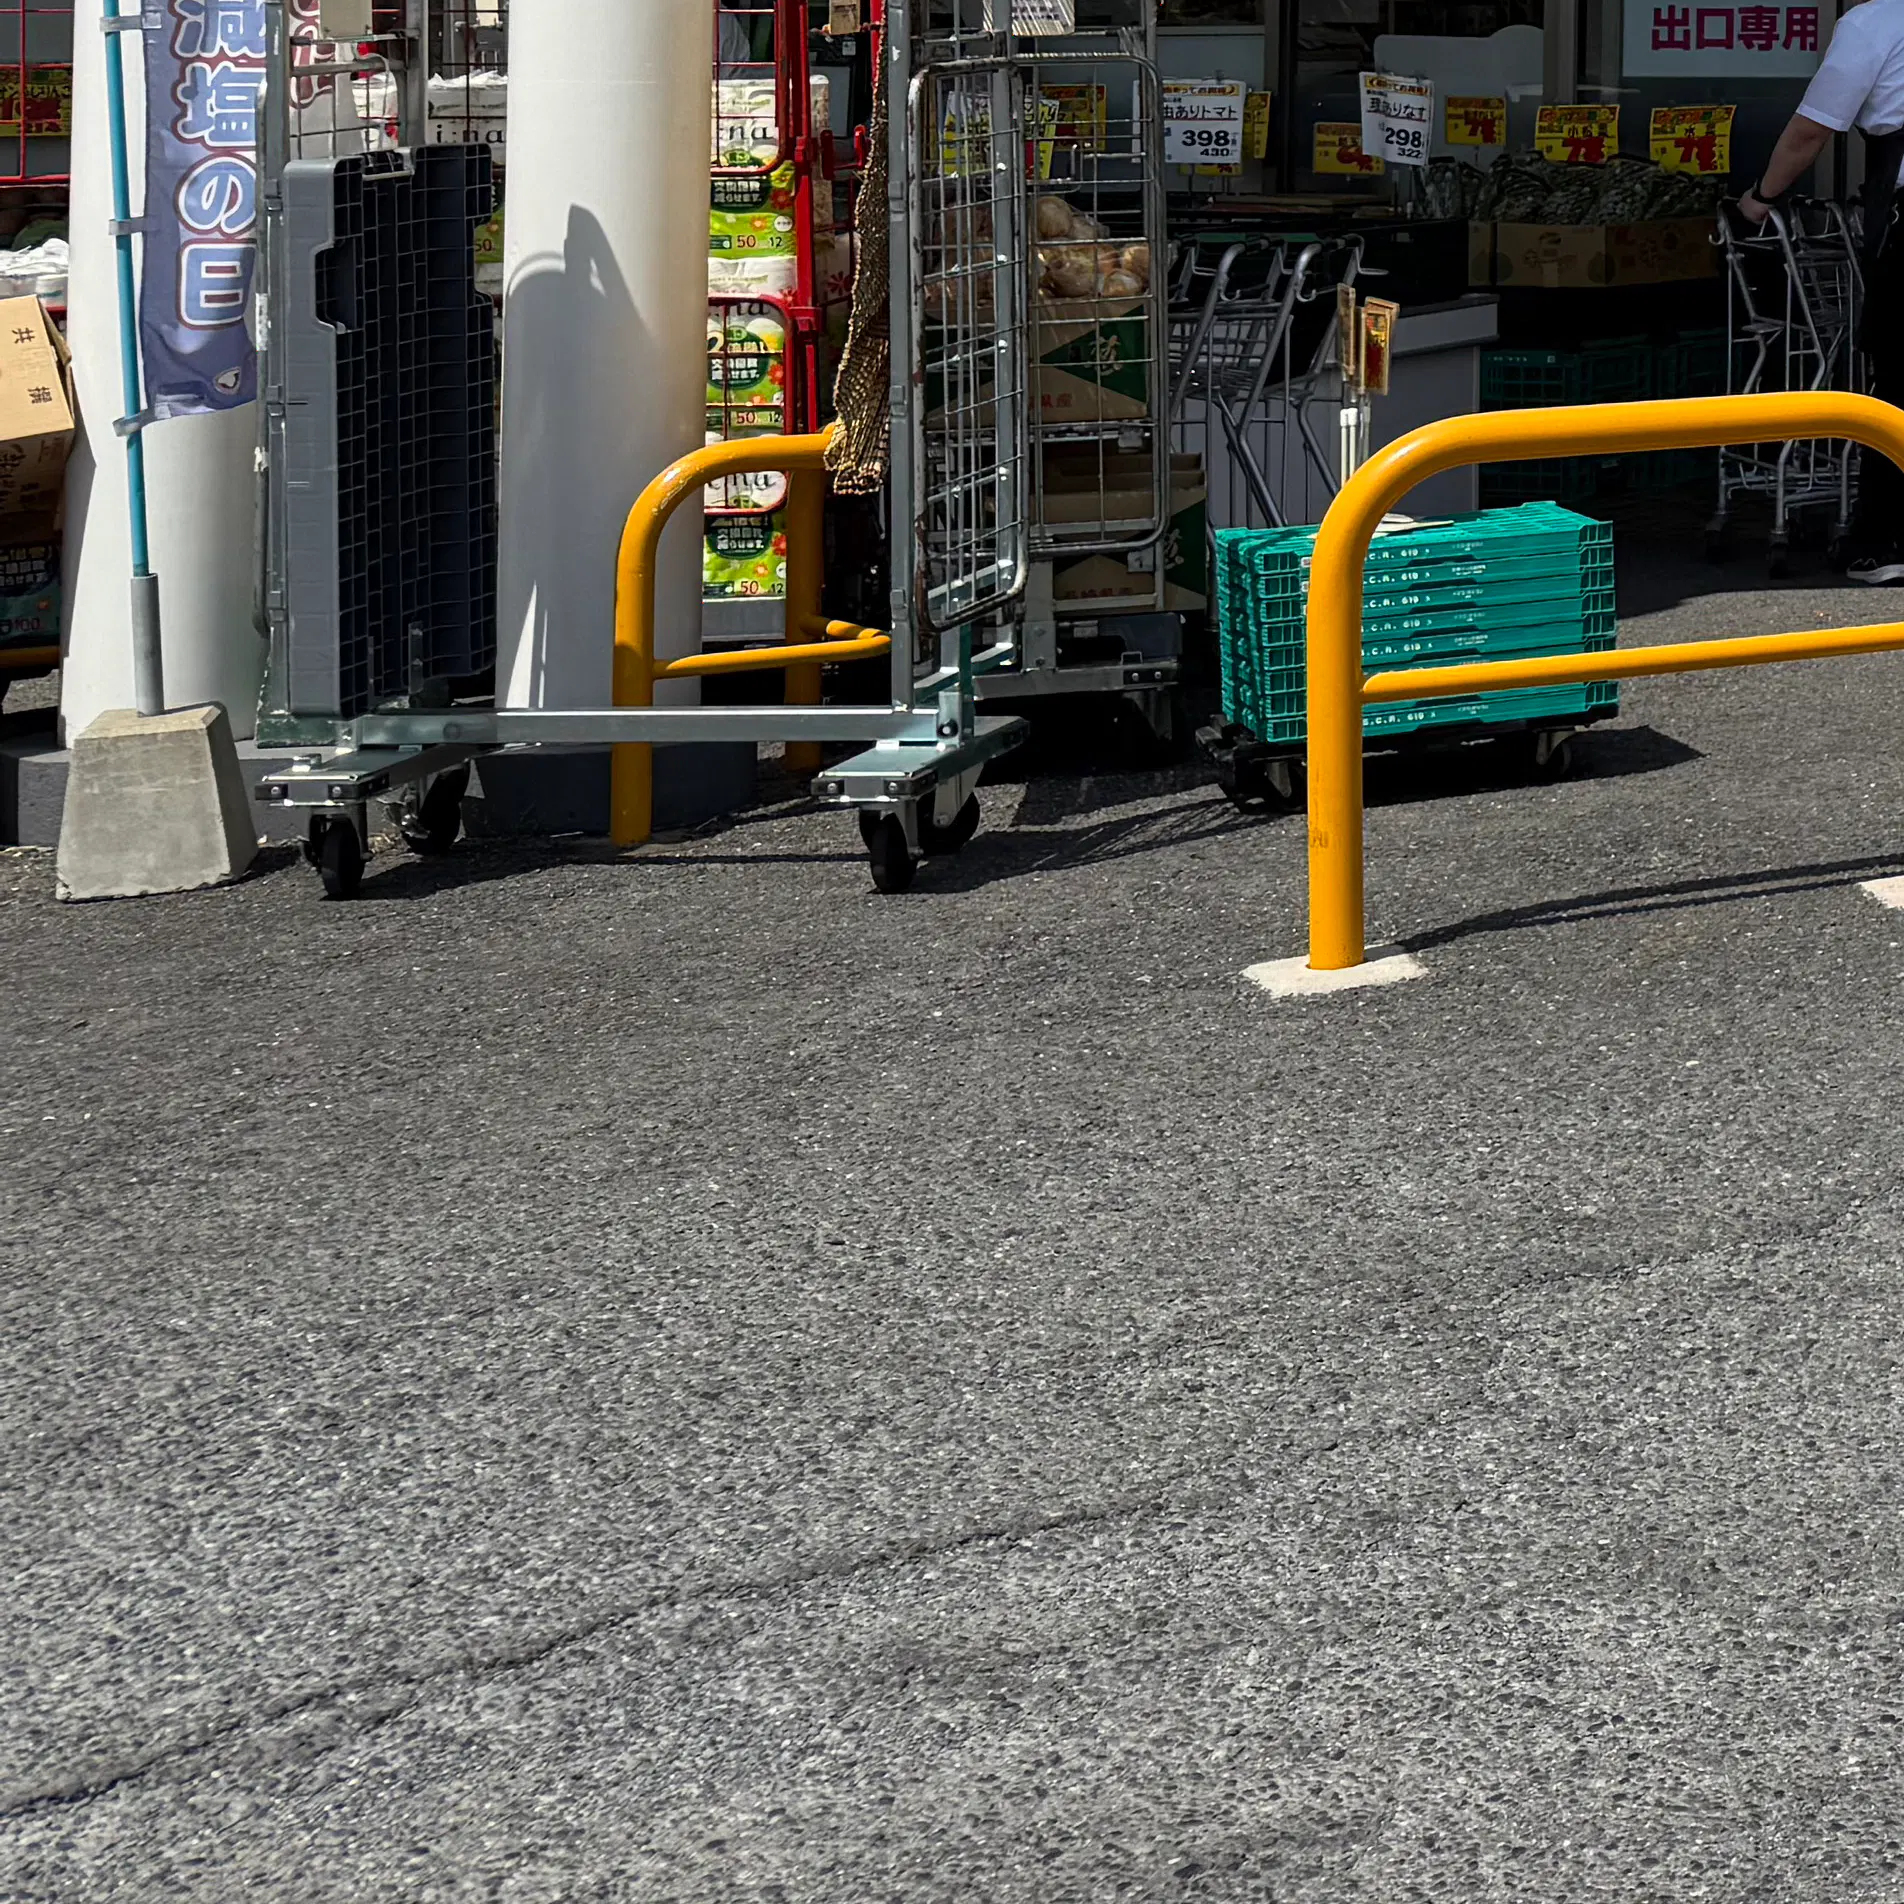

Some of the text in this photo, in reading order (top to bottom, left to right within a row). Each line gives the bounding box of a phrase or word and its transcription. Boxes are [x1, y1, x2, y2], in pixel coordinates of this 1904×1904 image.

[1650, 5, 1818, 52] 出口専用
[1182, 130, 1229, 146] 398
[1385, 127, 1422, 148] 298
[737, 235, 783, 248] 50 12
[737, 412, 781, 424] 50 12
[741, 581, 759, 594] 50
